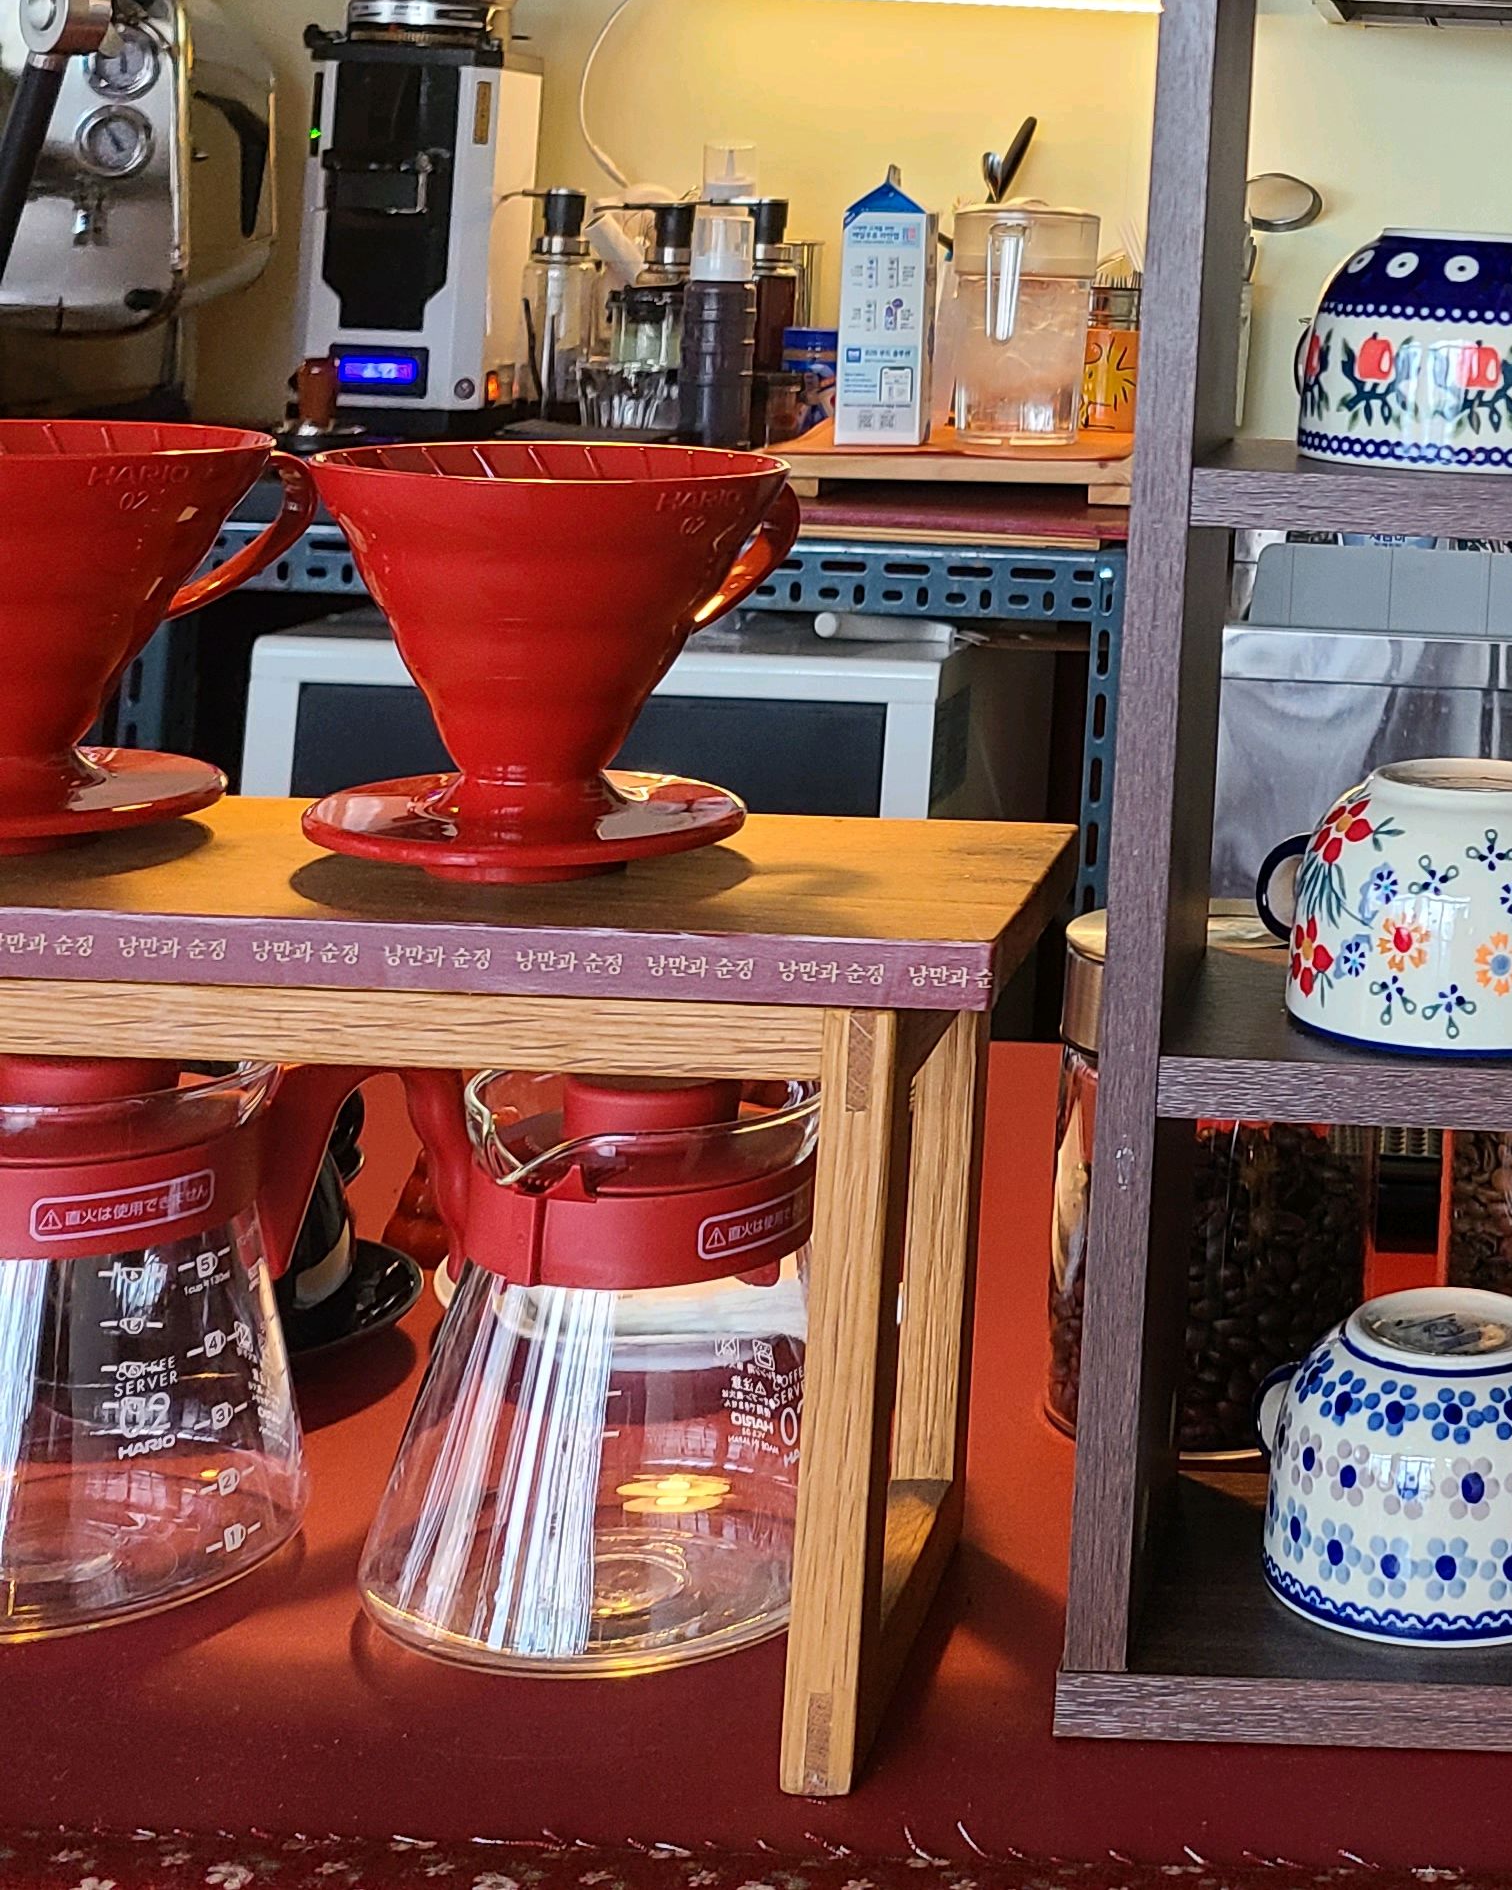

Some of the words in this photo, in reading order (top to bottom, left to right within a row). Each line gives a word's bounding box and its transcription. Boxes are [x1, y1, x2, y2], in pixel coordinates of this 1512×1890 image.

[87, 464, 189, 487] HARIO
[655, 488, 741, 513] HARIO
[53, 935, 94, 957] 순정
[118, 936, 181, 959] 낭만과
[186, 939, 227, 960] 순정
[251, 941, 314, 964] 낭만과
[319, 943, 359, 965] 순정
[384, 944, 446, 967] 낭만과
[452, 948, 491, 969] 순정
[515, 950, 578, 972] 낭만과
[583, 954, 623, 975] 순정
[646, 955, 708, 978] 낭만과
[714, 958, 754, 980] 순정
[778, 960, 840, 982] 낭만과
[845, 962, 885, 985] 순정
[909, 965, 970, 988] 낭만과
[114, 1371, 178, 1397] SERVER
[118, 1434, 175, 1460] HARIO
